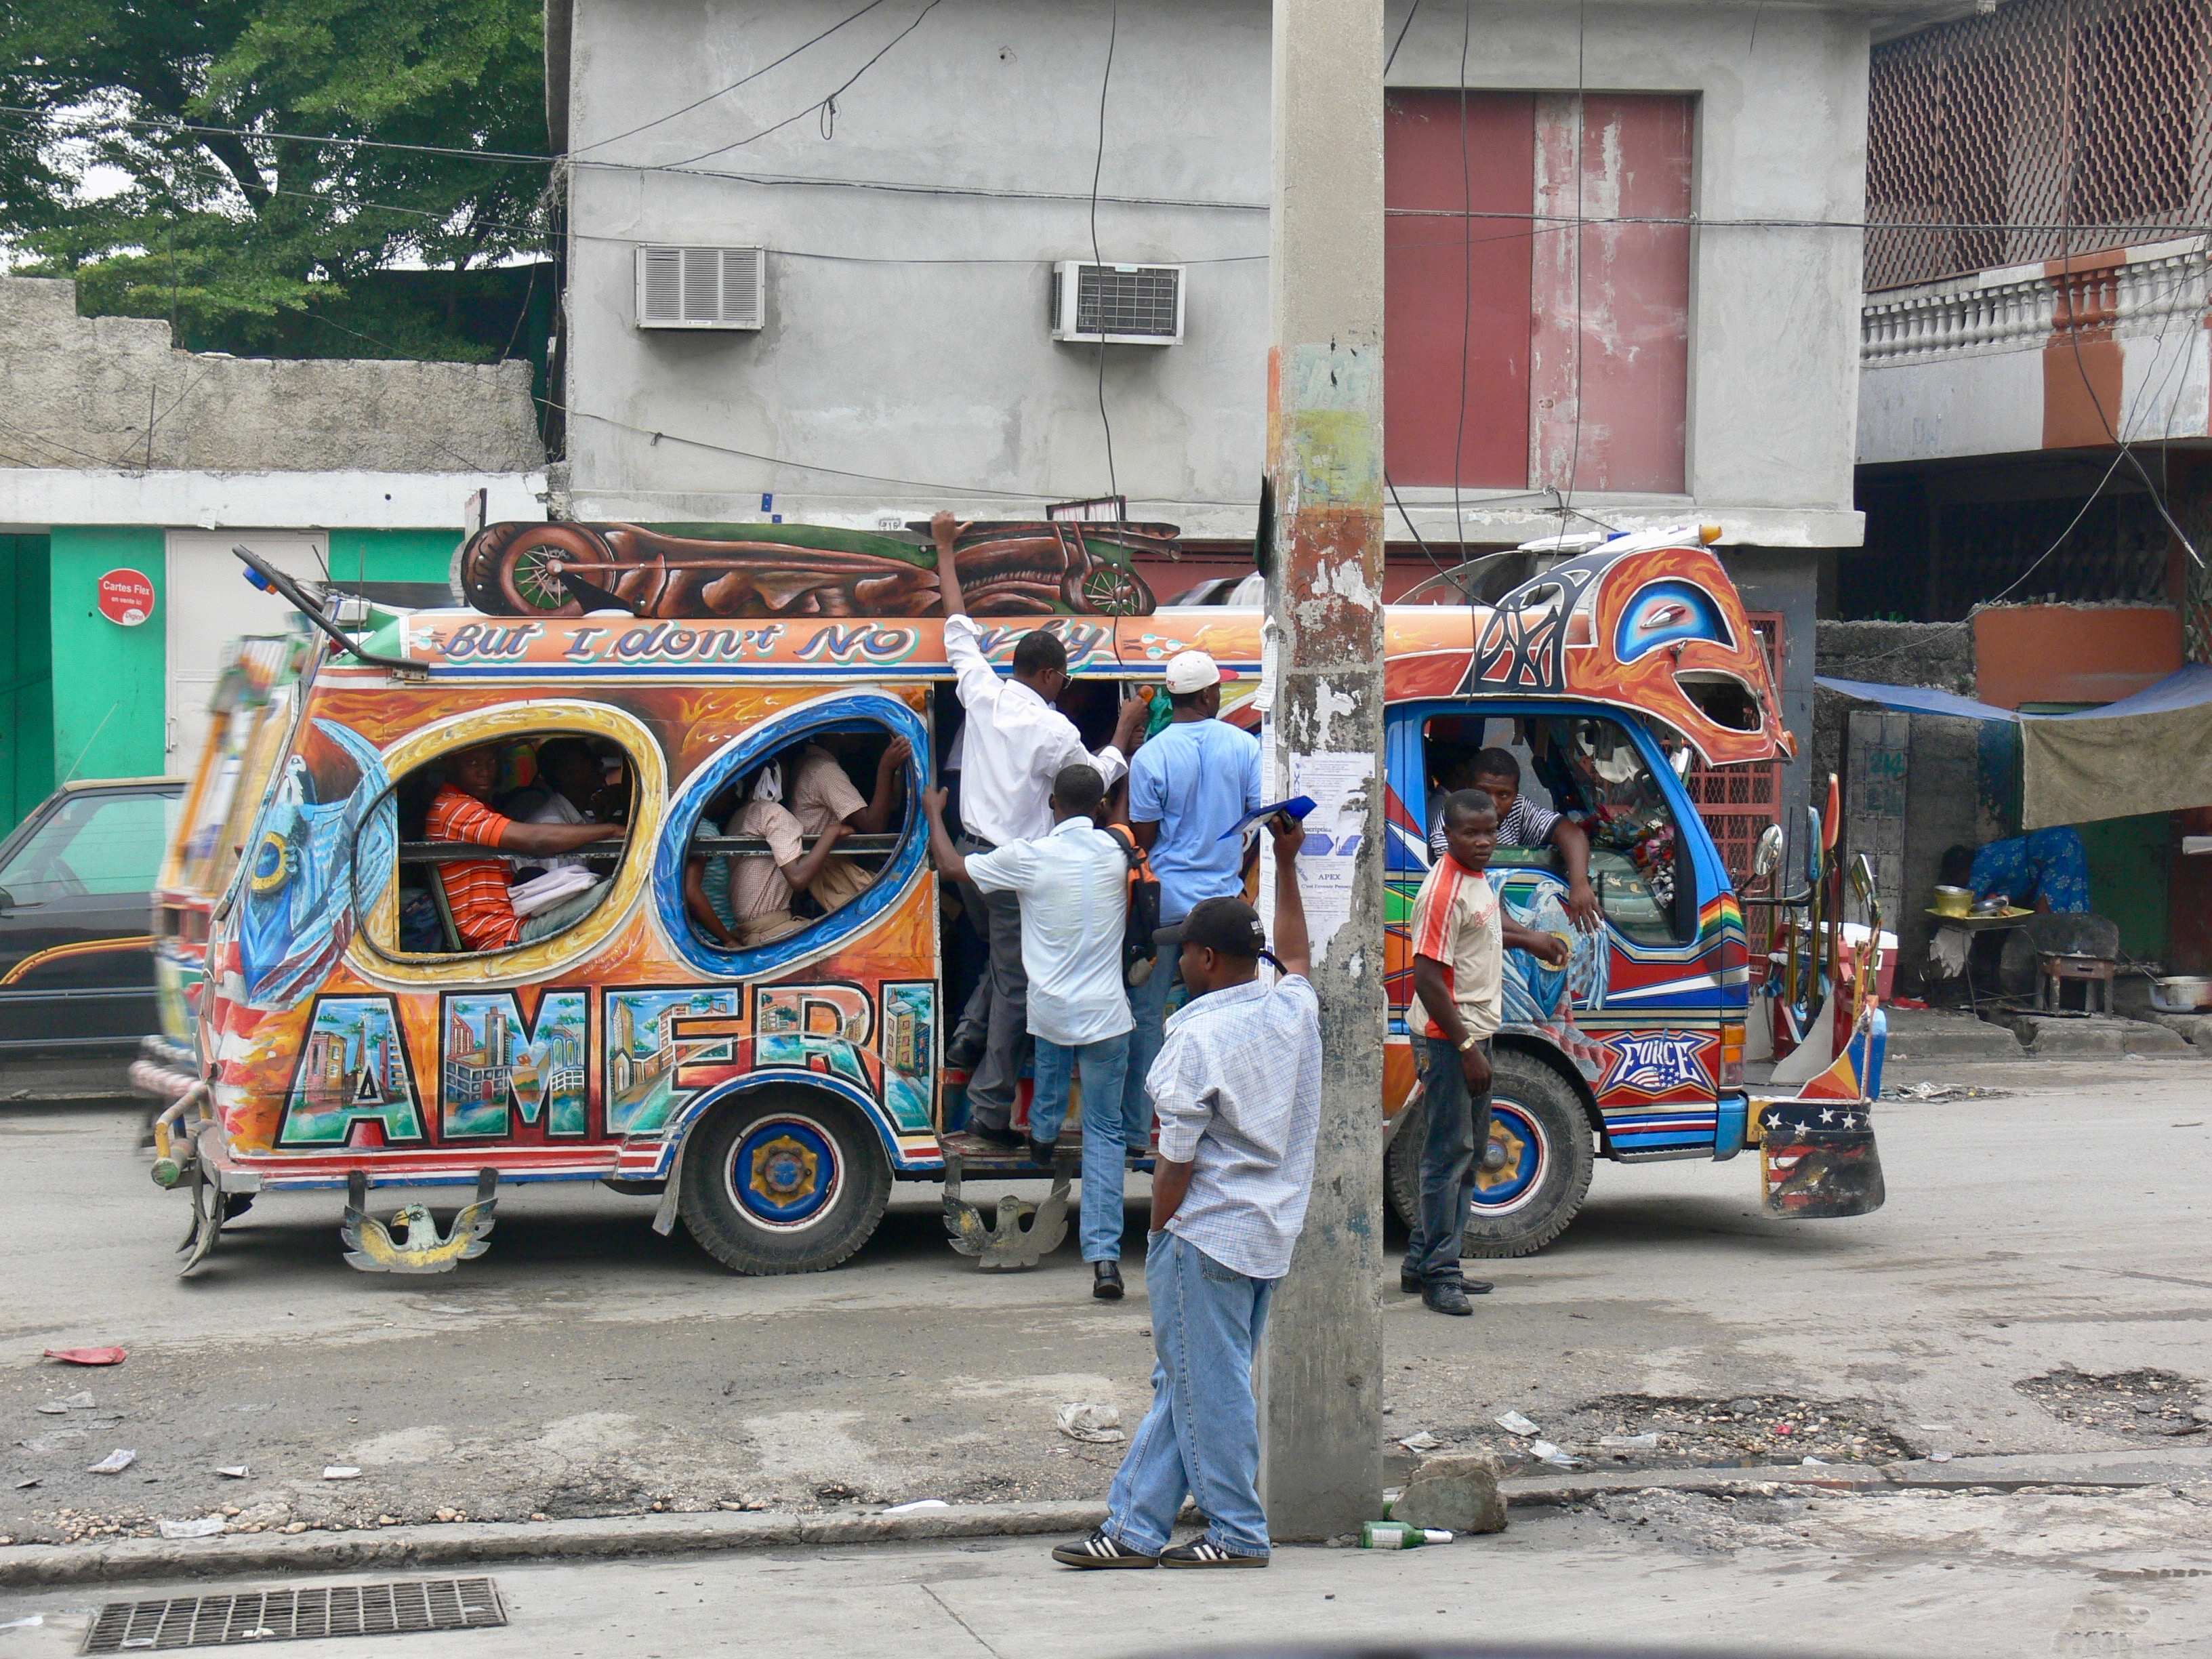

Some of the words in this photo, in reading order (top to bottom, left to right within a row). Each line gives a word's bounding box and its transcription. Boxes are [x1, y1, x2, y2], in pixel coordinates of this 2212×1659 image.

[103, 581, 131, 593] Cartes
[134, 584, 150, 595] Flex
[438, 621, 545, 665] But
[562, 626, 611, 662] I
[607, 620, 788, 663] don't
[1612, 1040, 1702, 1084] FORCE
